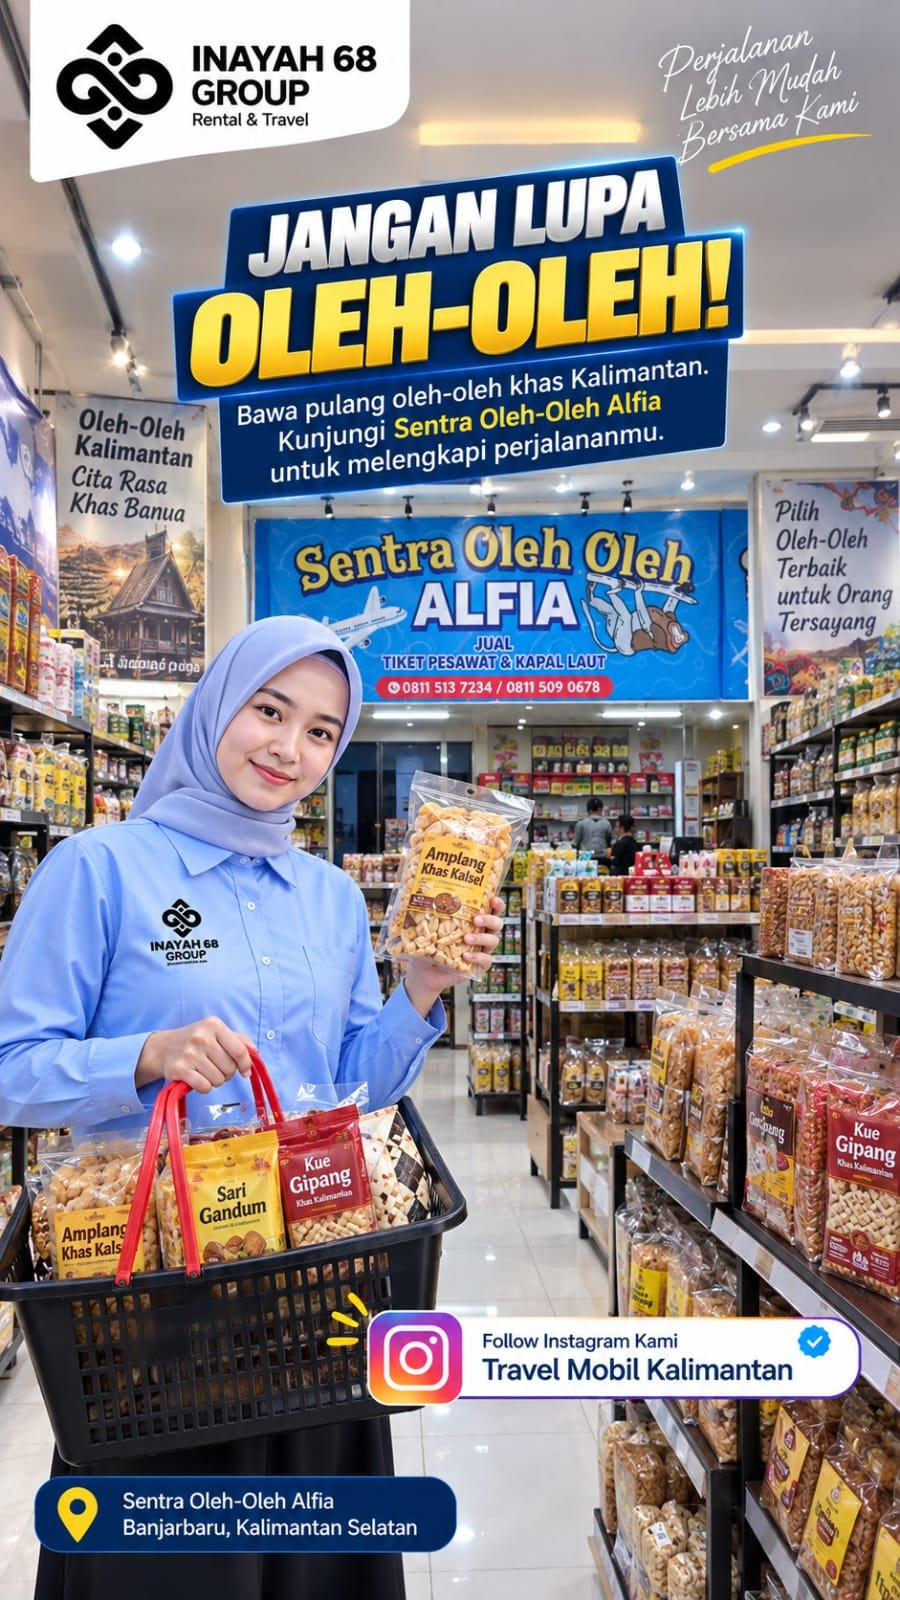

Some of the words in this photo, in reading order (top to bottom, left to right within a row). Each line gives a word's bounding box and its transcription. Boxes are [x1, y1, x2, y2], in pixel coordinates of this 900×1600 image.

[79, 408, 186, 442] Oleh-Oleh
[74, 434, 193, 468] Kalimantan
[72, 465, 113, 490] Cita
[119, 470, 168, 495] Rasa
[70, 492, 119, 517] Khas
[124, 497, 186, 523] Banua
[775, 499, 820, 523] Pilih
[776, 528, 868, 551] Oleh-Oleh
[295, 534, 454, 592] Sentra
[464, 524, 571, 570] Oleh
[584, 530, 693, 584] Oleh
[777, 556, 848, 580] Terbaik
[413, 581, 578, 626] ALFIA
[777, 584, 832, 606] untuk
[837, 583, 893, 609] Orang
[778, 611, 876, 637] Tersayang
[475, 636, 513, 653] JUAL
[383, 655, 424, 670] TIKET
[428, 655, 496, 670] PESAWAT
[501, 655, 511, 670] &
[516, 655, 565, 670] KAPAL
[568, 655, 606, 670] LAUT
[403, 681, 431, 695] 0811
[434, 681, 456, 695] 513
[459, 681, 493, 695] 7234
[496, 681, 502, 695] /
[507, 681, 535, 695] 0811
[538, 681, 564, 695] 509
[567, 681, 600, 695] 0678
[425, 847, 487, 874] Amplang
[421, 863, 449, 880] Khas
[450, 868, 485, 888] Kalsel
[150, 939, 201, 952] INAYAH
[204, 939, 219, 949] 68
[166, 950, 207, 962] GROUP
[854, 1122, 880, 1141] Kue
[835, 1135, 897, 1168] Gipang
[304, 1156, 331, 1173] Kue
[217, 1182, 247, 1203] Sari
[289, 1168, 351, 1195] Gipang
[199, 1201, 267, 1225] Gandum
[62, 1246, 92, 1261] Khas
[95, 1241, 122, 1259] Kals
